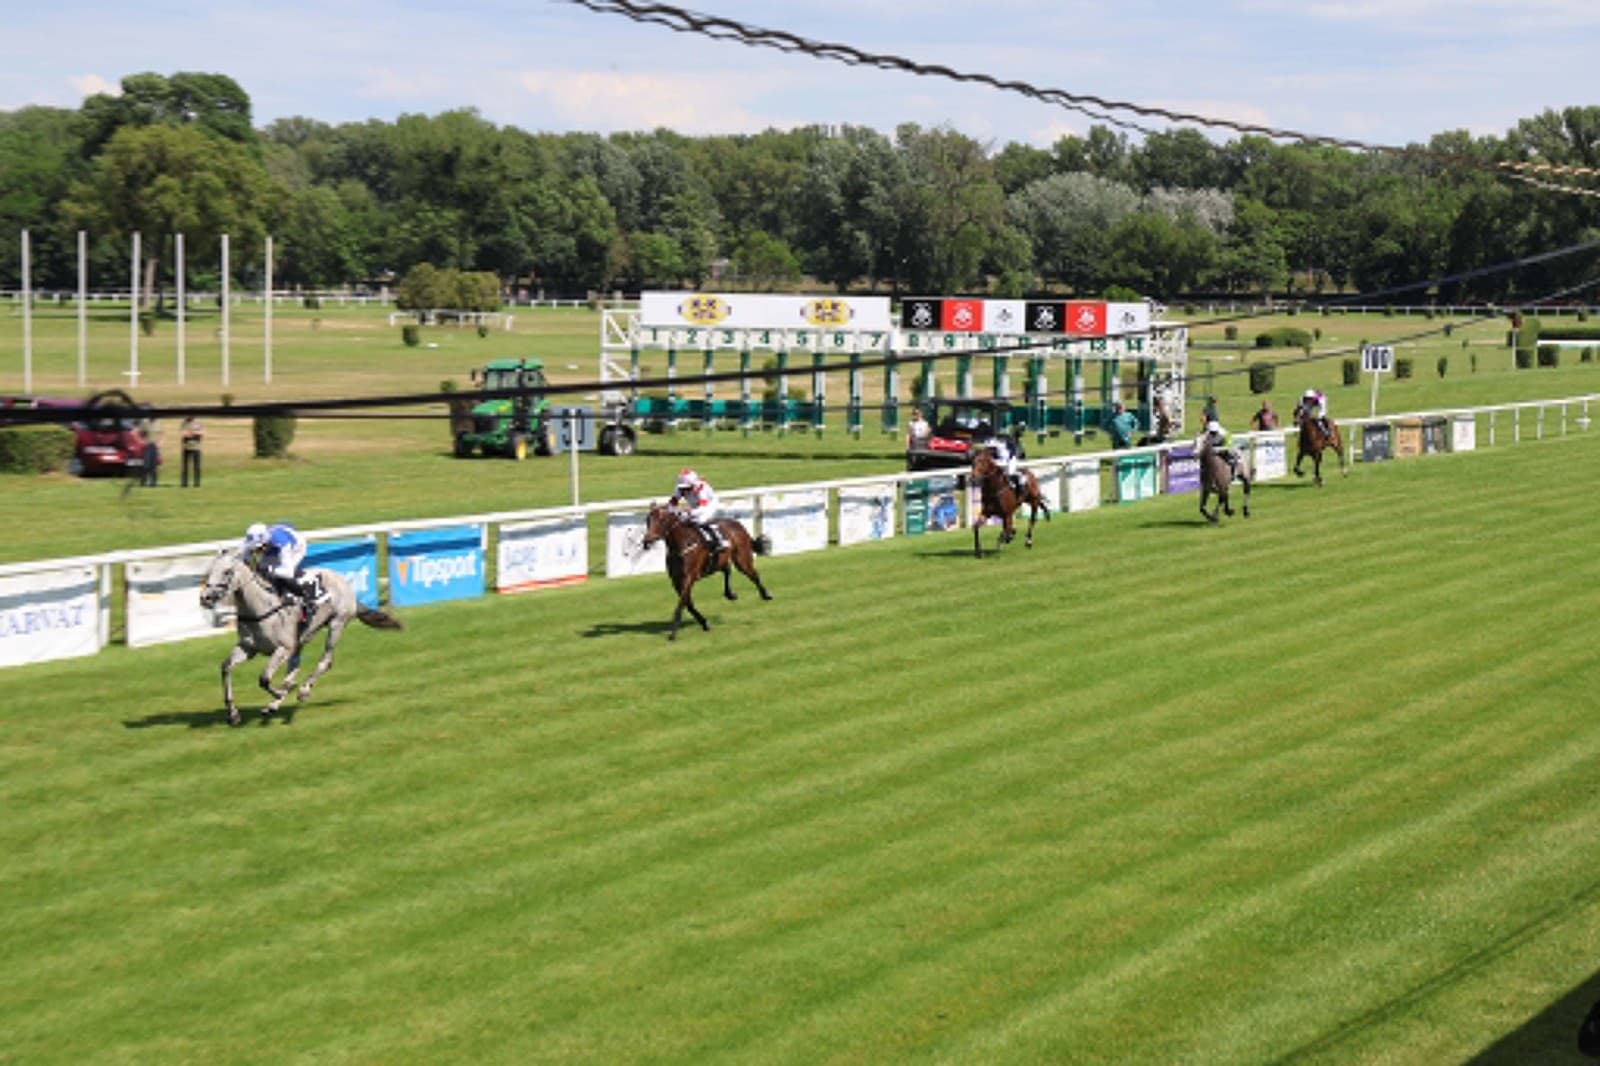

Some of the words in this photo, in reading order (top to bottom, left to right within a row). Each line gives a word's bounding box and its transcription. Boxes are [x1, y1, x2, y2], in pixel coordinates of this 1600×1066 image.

[650, 328, 658, 342] 1
[687, 329, 697, 343] 2
[723, 329, 733, 344] 3
[759, 329, 770, 344] 4
[796, 330, 807, 345] 5
[834, 331, 844, 346] 6
[871, 332, 882, 346] 7
[944, 334, 955, 348] 9
[1364, 348, 1389, 369] 100
[410, 550, 476, 588] Tipsport
